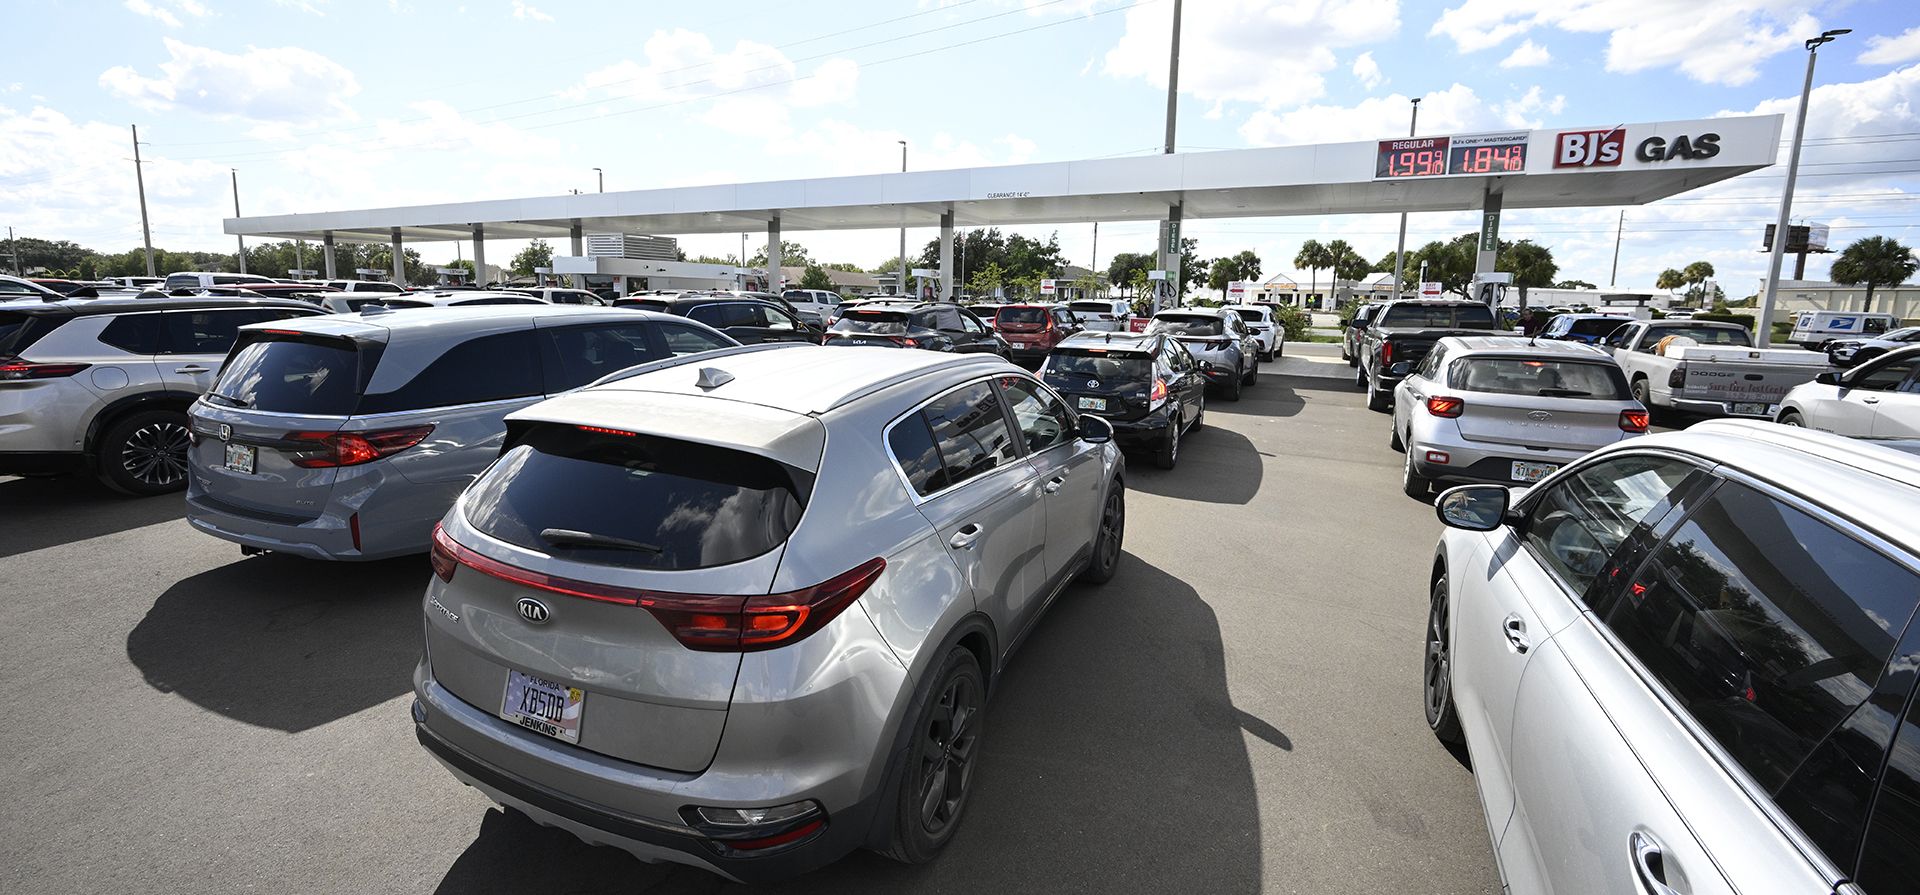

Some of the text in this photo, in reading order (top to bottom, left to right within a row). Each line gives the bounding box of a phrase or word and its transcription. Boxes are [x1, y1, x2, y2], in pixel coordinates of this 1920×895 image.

[1392, 139, 1434, 150] REGULAR
[1635, 132, 1721, 164] GAS
[987, 191, 1016, 199] CLEARANCE
[1485, 215, 1496, 251] DIESEL
[519, 601, 543, 620] KIA
[530, 675, 560, 691] FLORIDA
[519, 716, 557, 737] JENKINS
